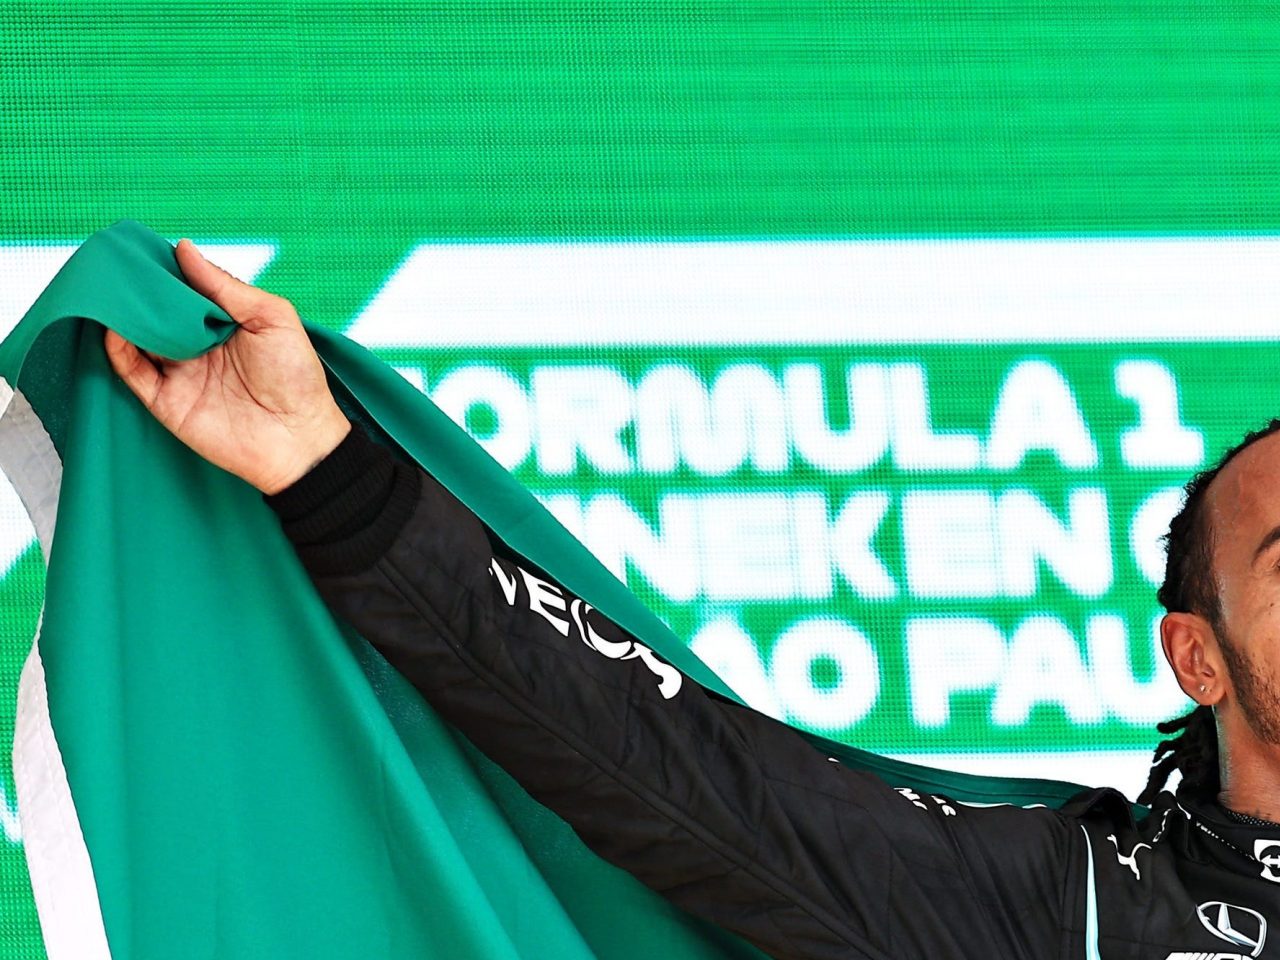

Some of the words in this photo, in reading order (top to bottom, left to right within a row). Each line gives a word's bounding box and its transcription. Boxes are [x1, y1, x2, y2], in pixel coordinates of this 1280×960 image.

[393, 362, 1098, 474] ORMULA
[1113, 360, 1203, 468] 1
[538, 488, 1114, 600] NEKEN
